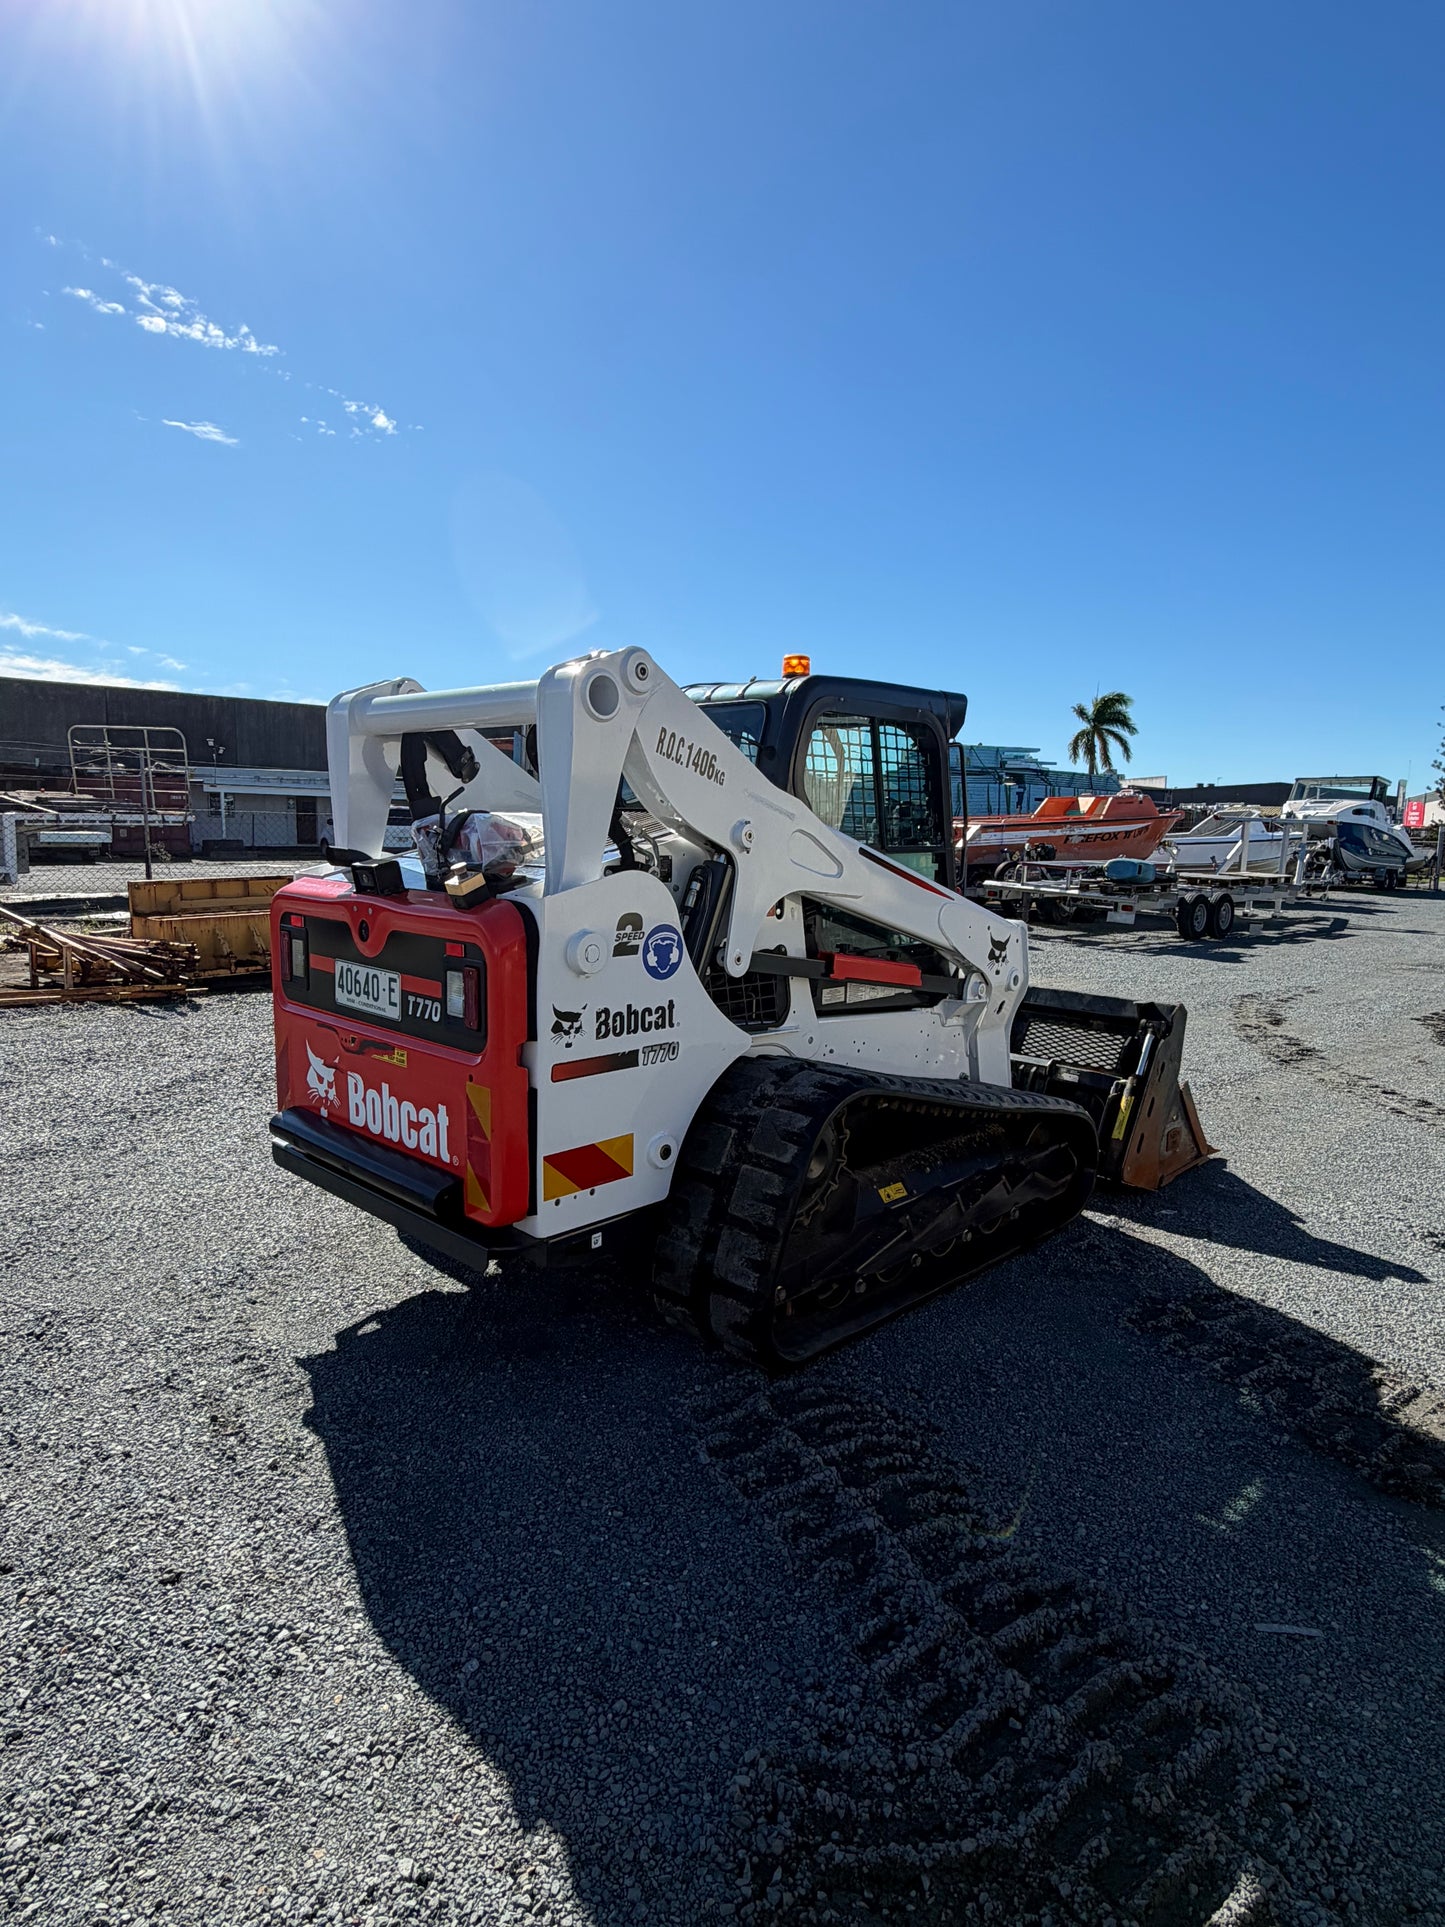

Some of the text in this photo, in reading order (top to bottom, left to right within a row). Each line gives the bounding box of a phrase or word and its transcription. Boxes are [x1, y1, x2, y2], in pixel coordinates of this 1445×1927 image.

[1063, 831, 1120, 844] FREFOX
[612, 912, 643, 957] 2
[614, 931, 645, 942] SPEED
[407, 995, 441, 1022] T770
[596, 999, 675, 1040] Bobcat
[642, 1041, 679, 1066] T770
[347, 1071, 450, 1163] Bobcat
